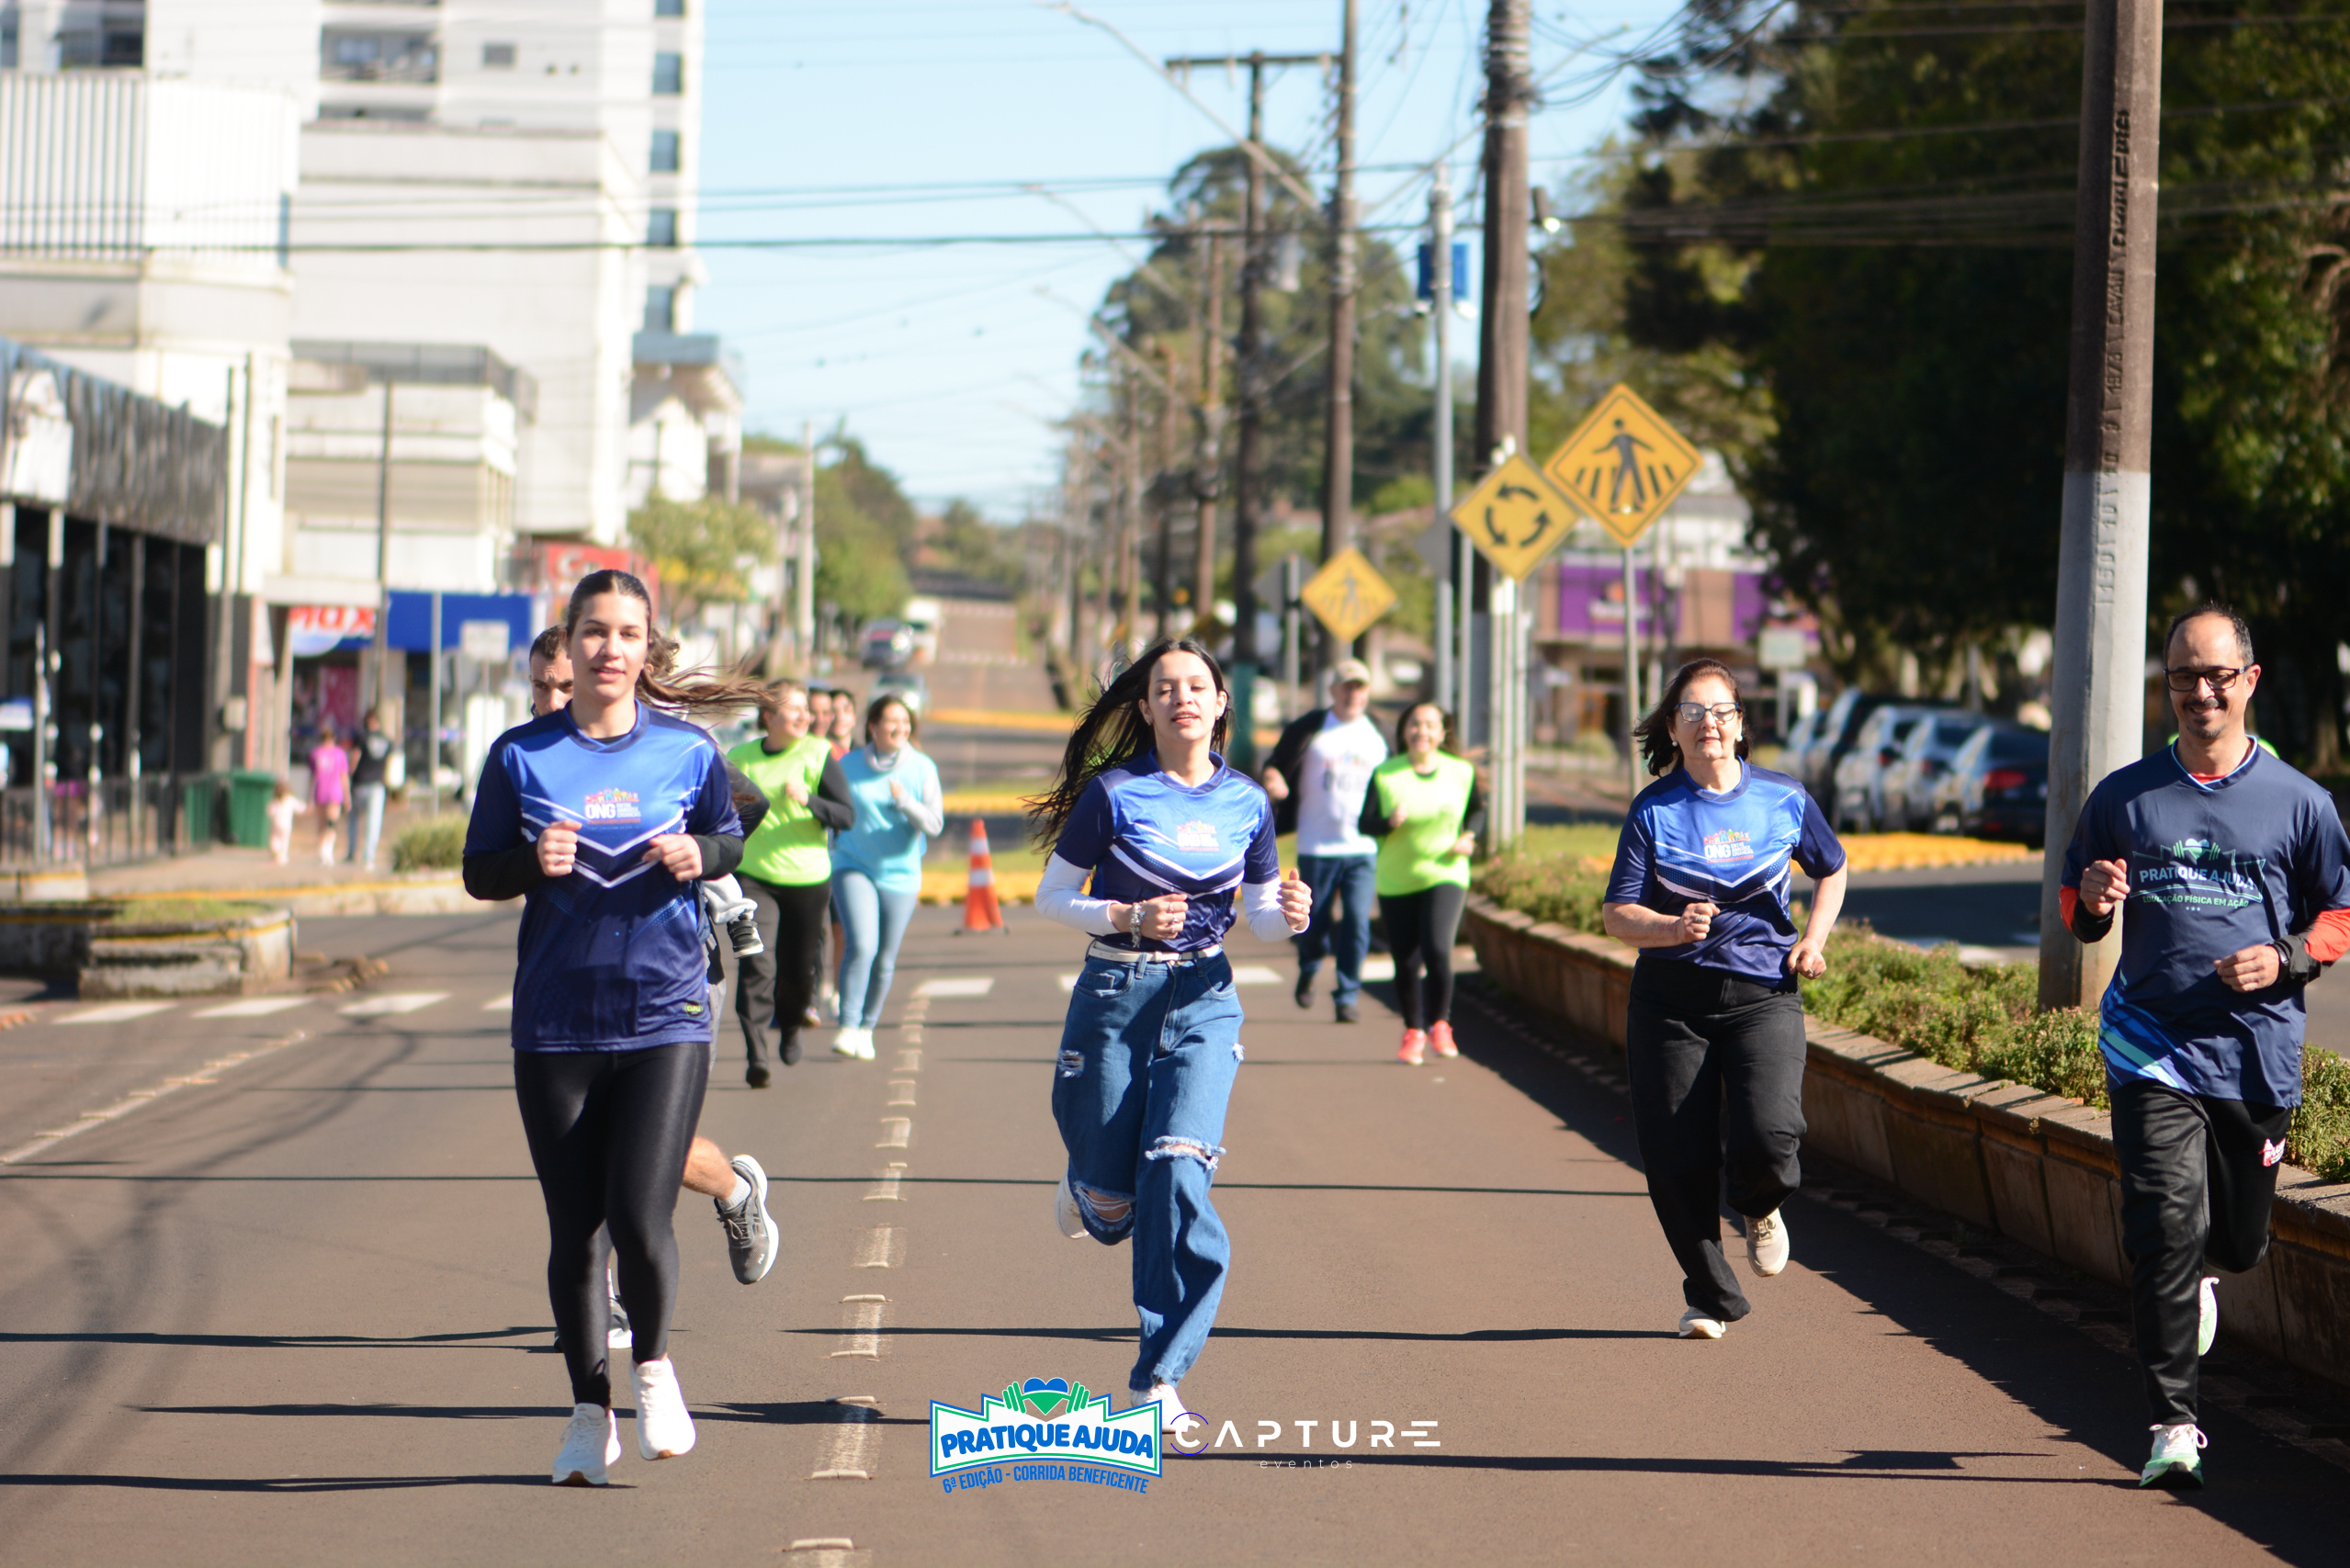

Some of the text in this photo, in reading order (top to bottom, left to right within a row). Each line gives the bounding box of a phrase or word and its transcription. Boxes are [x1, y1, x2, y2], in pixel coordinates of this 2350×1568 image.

[585, 803, 616, 818] ONG
[1705, 844, 1731, 858] ONG
[2140, 866, 2254, 890] PRATIQUE AJUDA
[2142, 894, 2249, 908] EDUCAÇÃO FÍSICA EM AÇÃO
